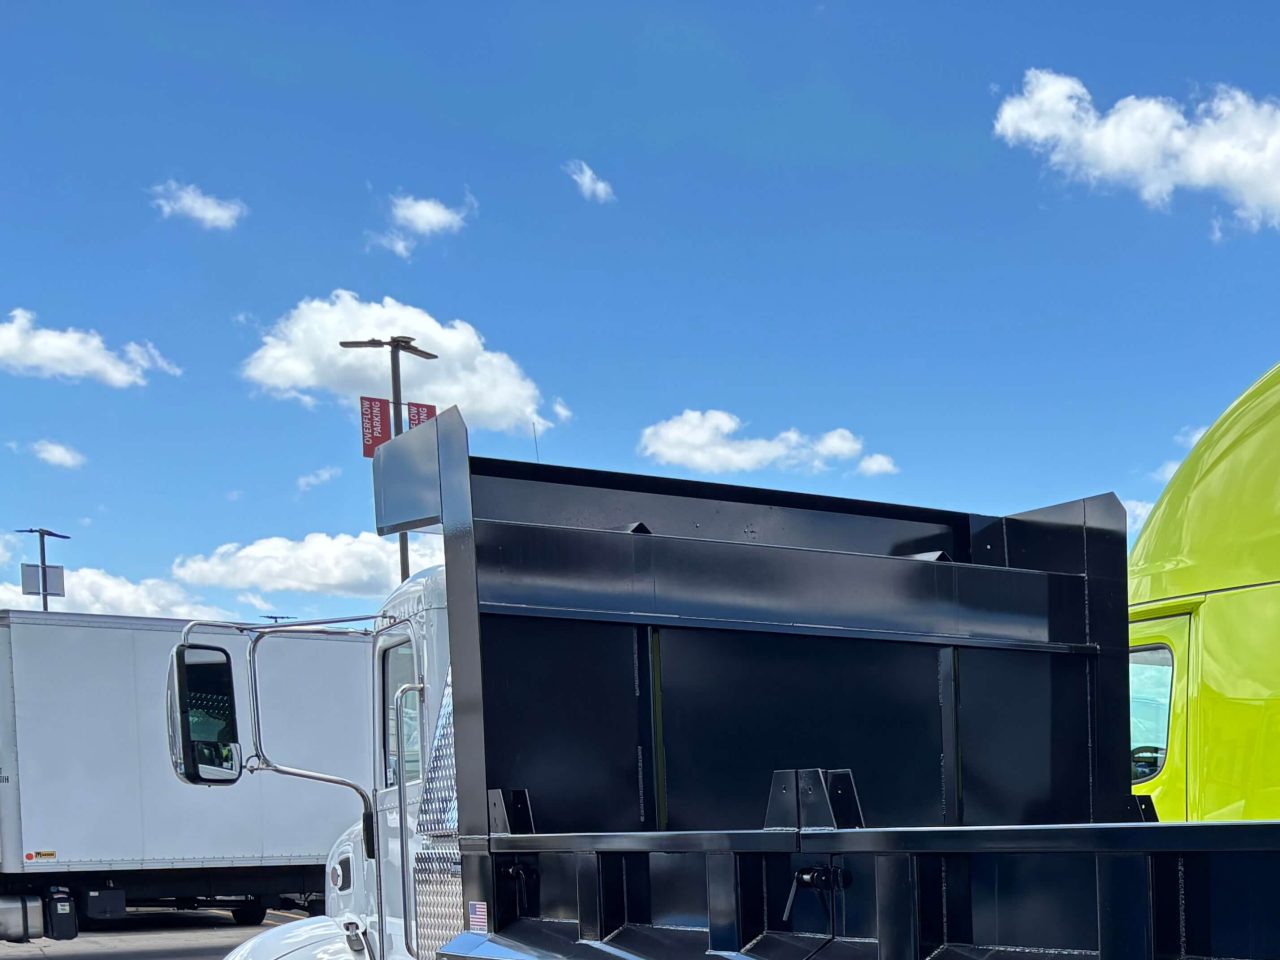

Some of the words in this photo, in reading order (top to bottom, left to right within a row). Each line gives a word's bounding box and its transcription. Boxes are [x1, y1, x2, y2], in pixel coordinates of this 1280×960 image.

[362, 400, 372, 445] OVERFLOW
[372, 401, 382, 437] PARKING
[410, 406, 418, 429] FLOW
